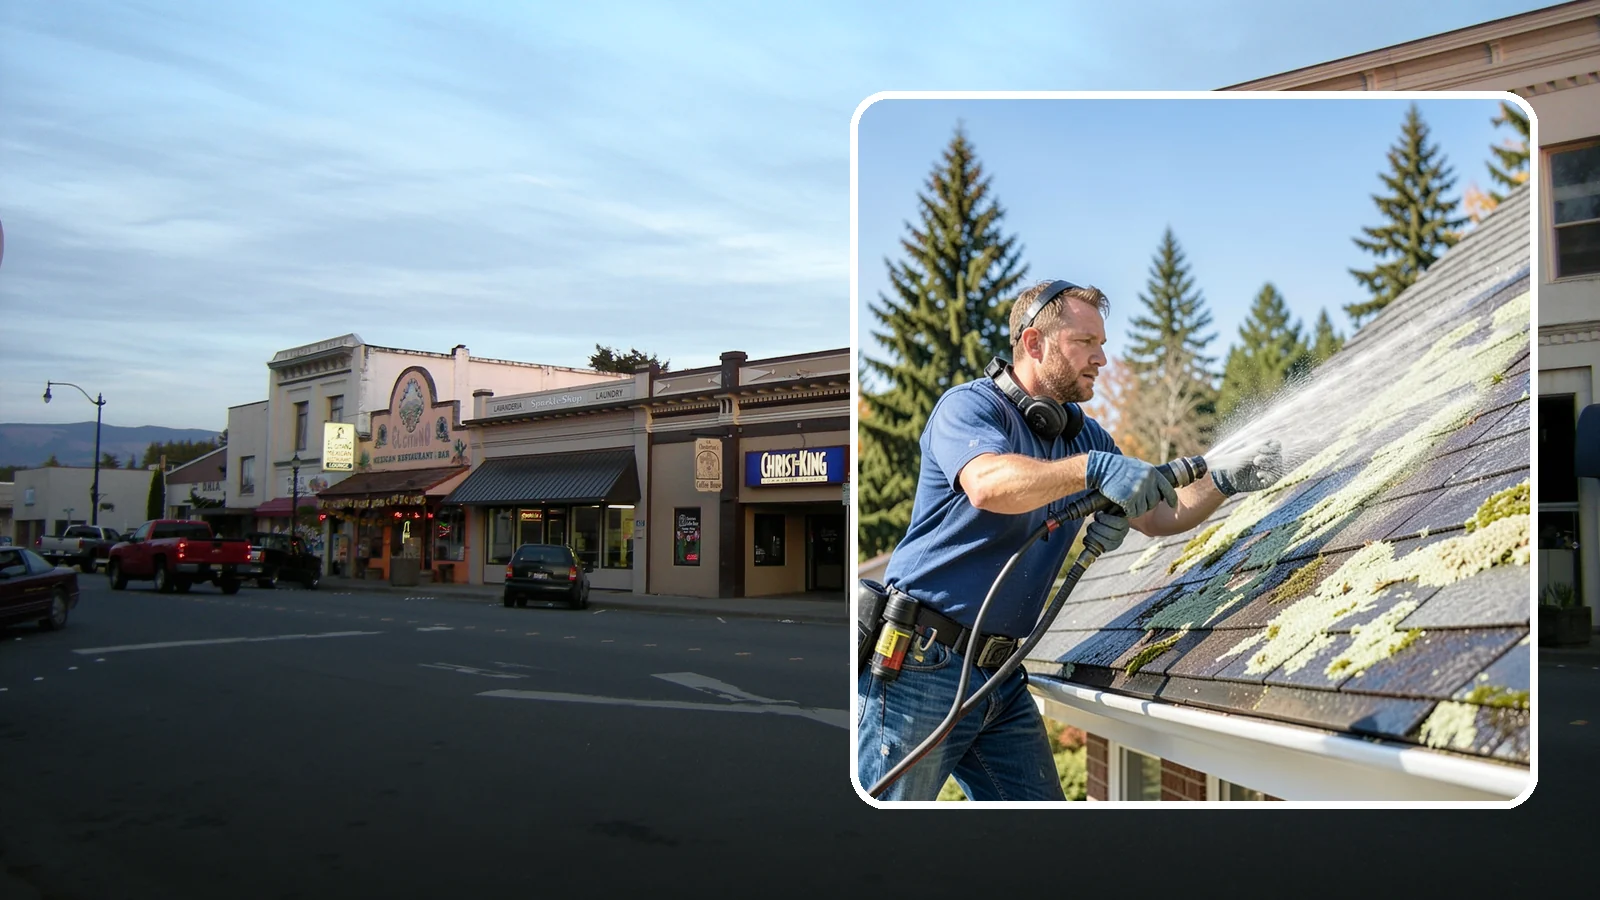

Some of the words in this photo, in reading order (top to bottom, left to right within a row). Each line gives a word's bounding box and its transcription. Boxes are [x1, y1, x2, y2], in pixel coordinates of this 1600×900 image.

[595, 389, 623, 399] LAUNDRY
[493, 402, 522, 412] LAVANDERIA
[373, 455, 396, 464] MEXICAN
[397, 452, 433, 462] RESTAURANT
[438, 450, 450, 459] BAR
[761, 452, 797, 477] CHRIST
[799, 450, 827, 476] KING
